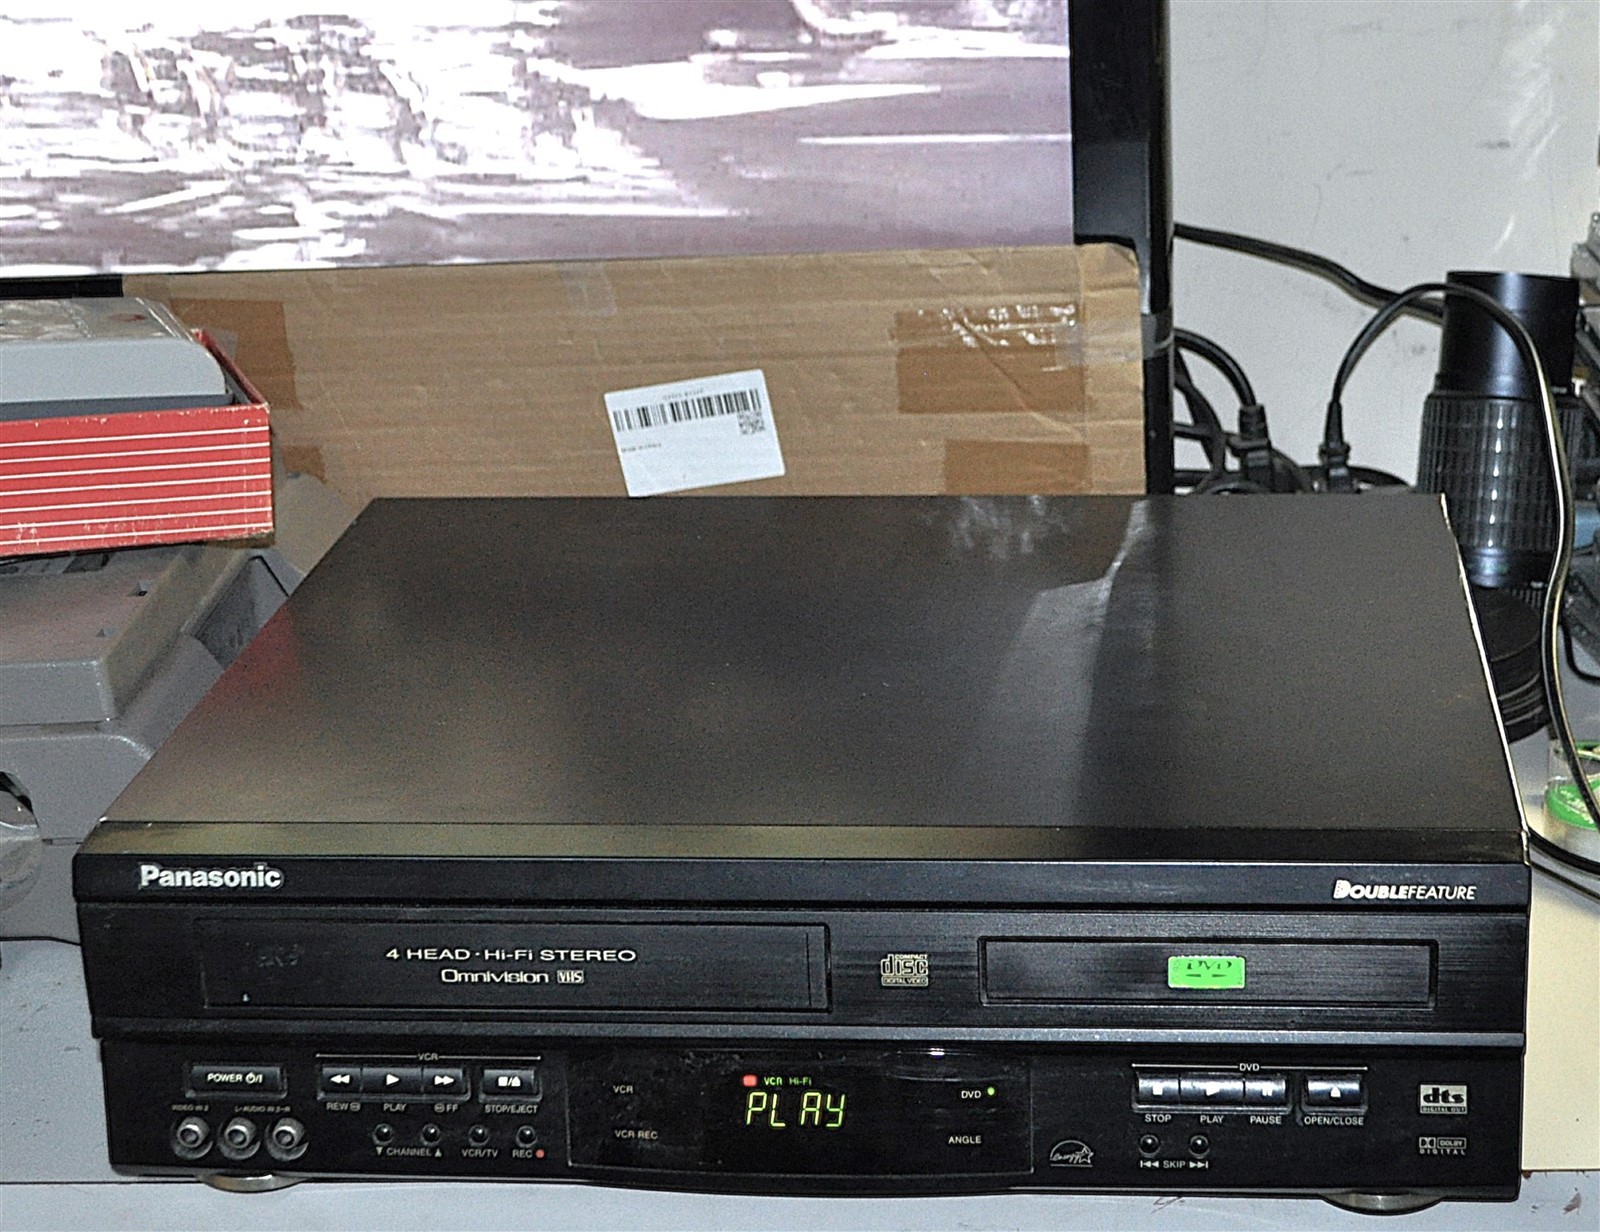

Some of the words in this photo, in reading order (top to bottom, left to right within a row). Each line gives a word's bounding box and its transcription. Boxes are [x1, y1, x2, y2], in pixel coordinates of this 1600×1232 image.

[140, 865, 281, 888] Panasonic
[386, 948, 399, 959] 4
[406, 948, 470, 960] HEAD
[485, 948, 533, 961] Hi-Fi
[540, 949, 637, 962] STEREO
[881, 954, 928, 976] disc
[441, 968, 549, 984] Omnivision
[557, 970, 584, 984] VHS
[418, 1053, 438, 1061] VCR
[1239, 1063, 1260, 1072] DVD
[207, 1073, 243, 1083] POWER
[764, 1076, 783, 1086] VCR
[789, 1076, 812, 1086] Hi-Fi
[613, 1084, 634, 1095] VCR
[961, 1090, 982, 1099] DVD
[1423, 1087, 1464, 1104] dts
[326, 1102, 348, 1111] REW
[383, 1103, 406, 1112] PLAY
[446, 1103, 458, 1112] FF
[484, 1104, 538, 1114] STOP/EJECT
[746, 1091, 846, 1127] PLAY
[1144, 1114, 1171, 1123] STOP
[1200, 1115, 1224, 1124] PLAY
[1250, 1116, 1282, 1124] PAUSE
[1304, 1116, 1364, 1126] OPEN/CLOSE
[614, 1129, 634, 1139] VCR
[637, 1130, 658, 1140] REC
[948, 1135, 982, 1144] ANGLE
[386, 1147, 431, 1157] CHANNEL
[462, 1149, 498, 1158] VCR/TV
[512, 1150, 532, 1158] REC
[1163, 1160, 1186, 1169] SKIP
